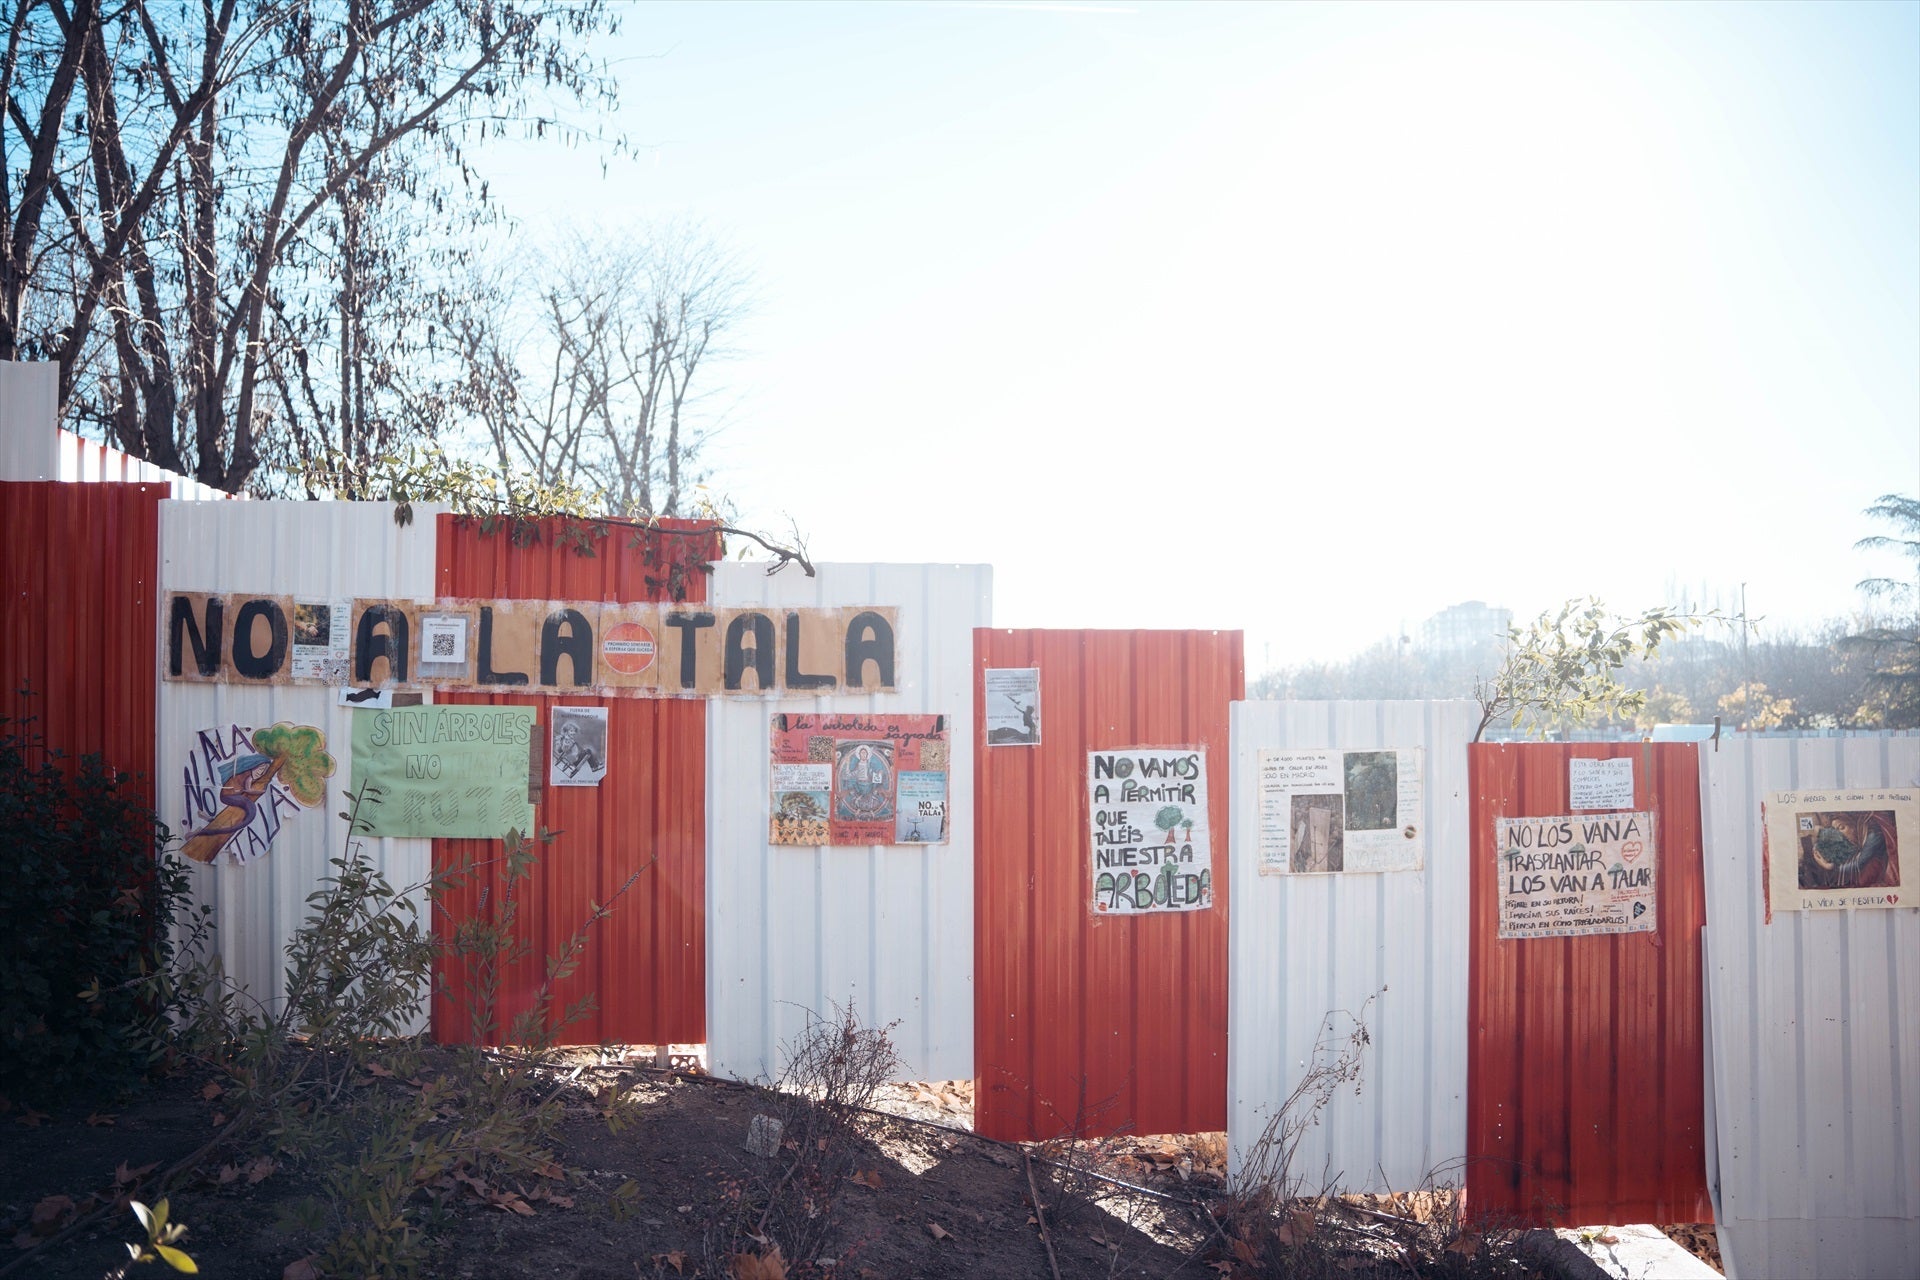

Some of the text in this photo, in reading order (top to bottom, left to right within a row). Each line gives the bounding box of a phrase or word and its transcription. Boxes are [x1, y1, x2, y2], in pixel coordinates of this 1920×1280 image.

[170, 596, 288, 681] NO
[356, 604, 409, 683] A
[477, 606, 594, 686] LA
[666, 609, 896, 690] TALA
[371, 708, 531, 746] SIN ÁRBOLES
[406, 754, 441, 779] NO
[1094, 754, 1199, 780] NO VAMOS
[918, 801, 932, 810] NO
[1094, 784, 1110, 803] A
[1776, 793, 1796, 804] LOS
[225, 784, 300, 862] TALA
[1095, 810, 1128, 830] QUE
[1508, 818, 1641, 848] NO LOS VAN A
[1096, 844, 1194, 869] NUESTRA
[1504, 850, 1607, 874] TRASPLANTAR
[1095, 868, 1211, 909] ARBOLEDA
[1509, 867, 1651, 894] LOS VAN A TALAR
[1802, 898, 1812, 909] LA
[1817, 897, 1834, 908] VIDA
[1838, 897, 1848, 906] SE
